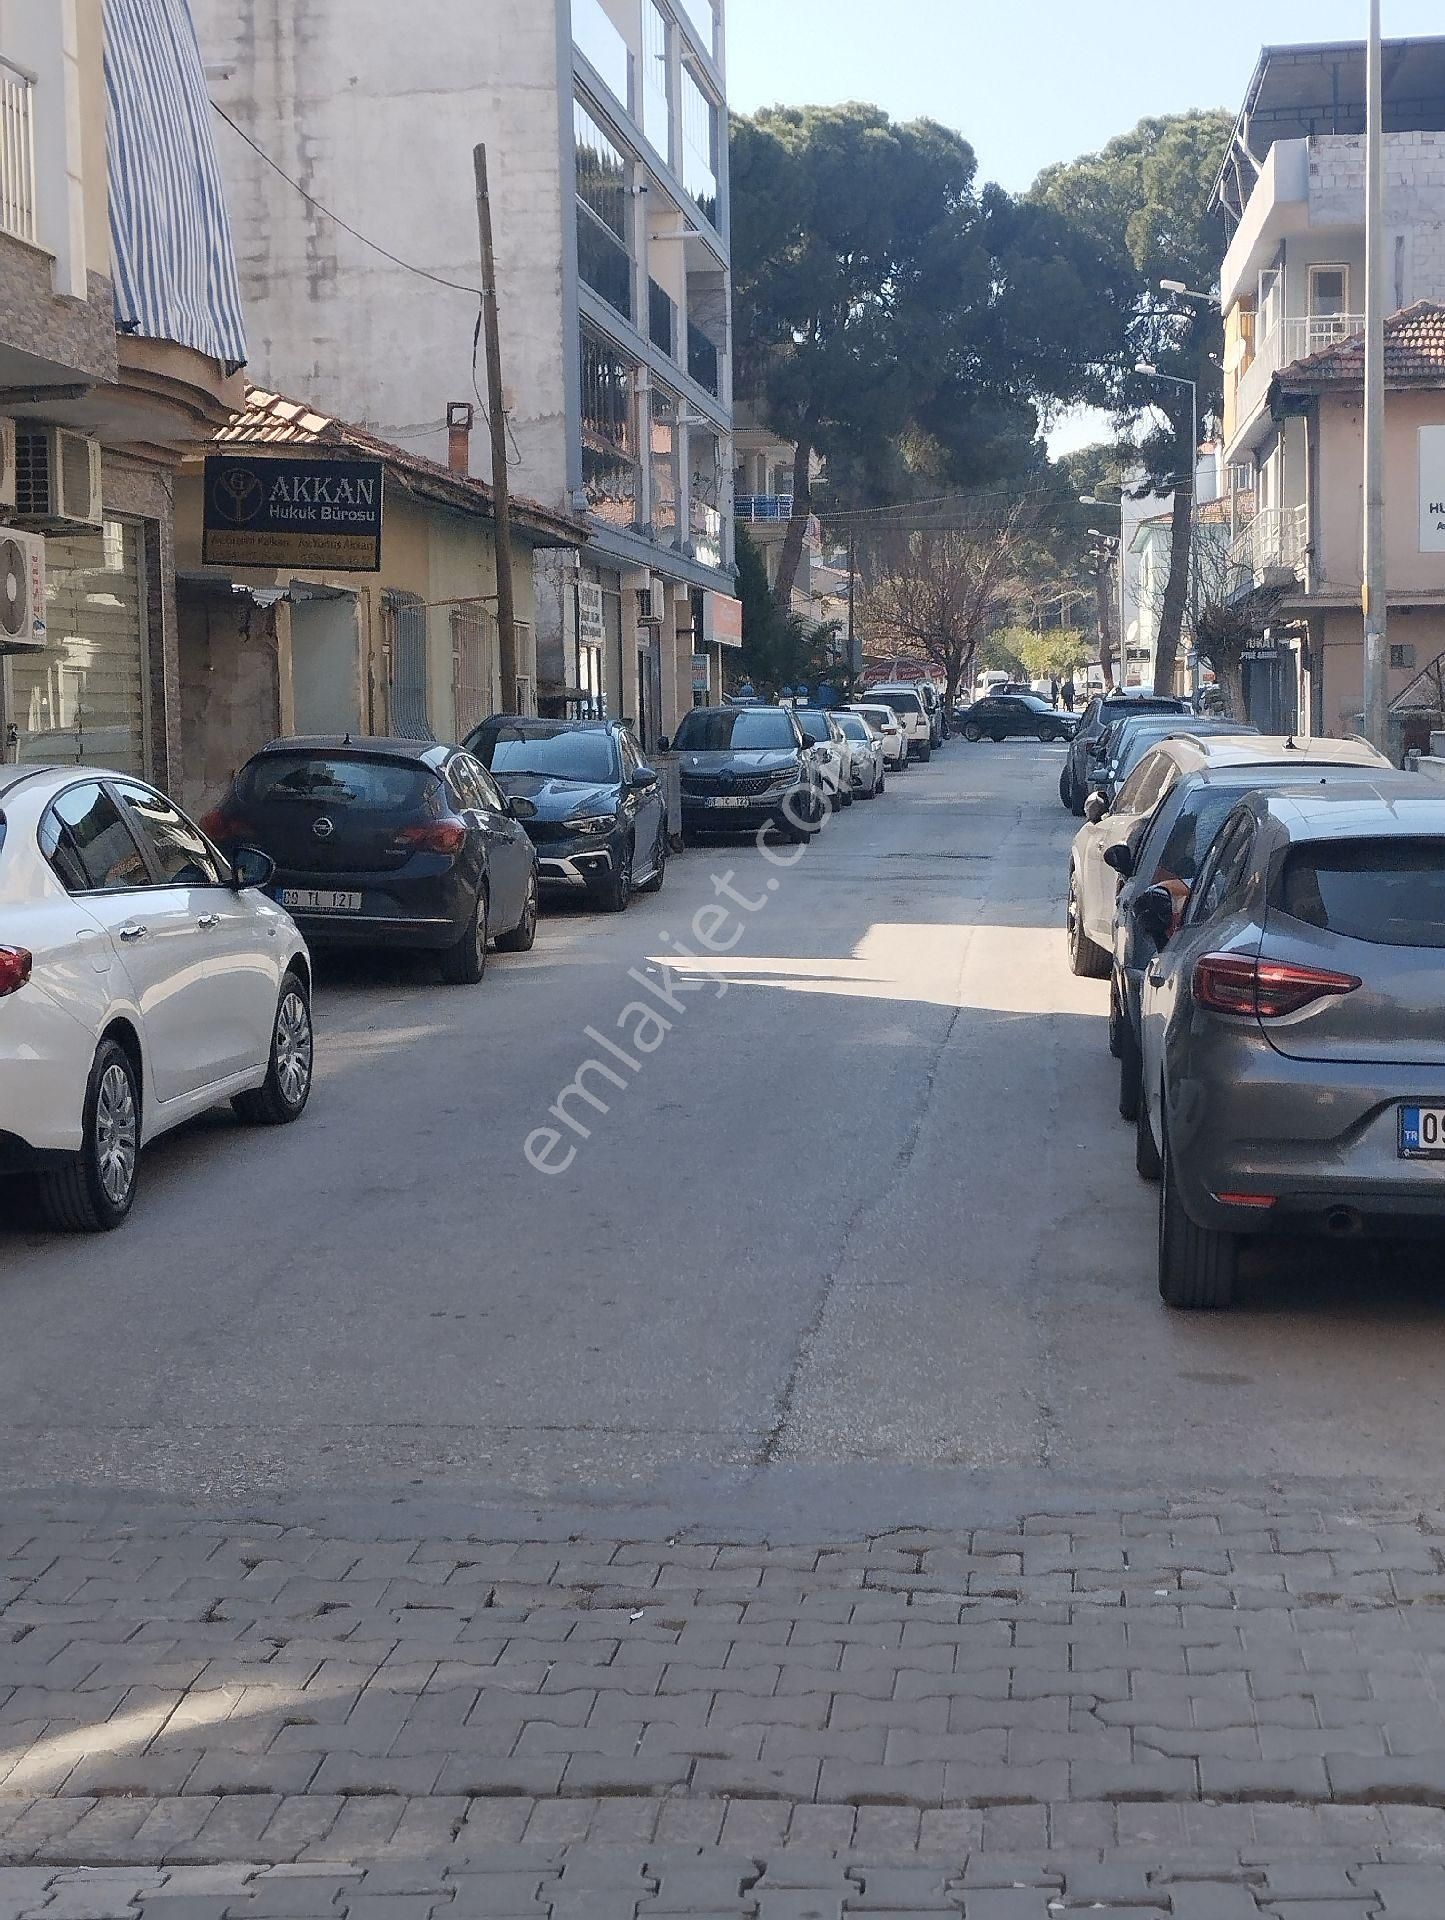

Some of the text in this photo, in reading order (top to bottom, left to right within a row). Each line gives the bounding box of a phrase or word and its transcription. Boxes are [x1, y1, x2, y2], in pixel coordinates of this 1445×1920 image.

[269, 476, 374, 505] AKKAN
[269, 504, 375, 522] Hukuk Bürosu
[1404, 1130, 1418, 1141] TR
